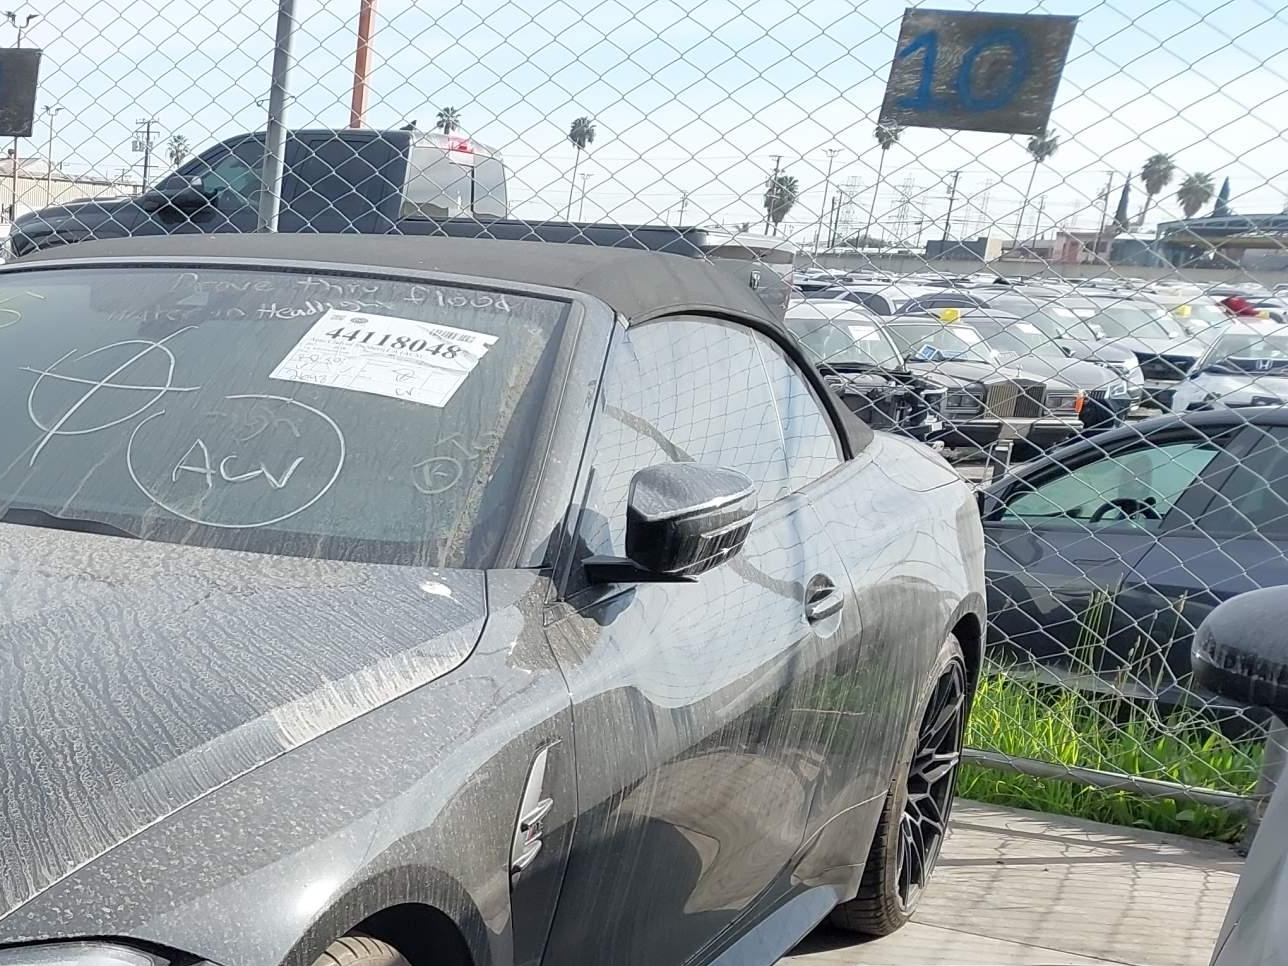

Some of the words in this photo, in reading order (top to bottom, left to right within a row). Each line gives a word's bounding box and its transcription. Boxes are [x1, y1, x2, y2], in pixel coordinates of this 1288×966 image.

[897, 28, 1030, 112] 10
[403, 285, 512, 312] flood
[324, 325, 463, 361] 44118048
